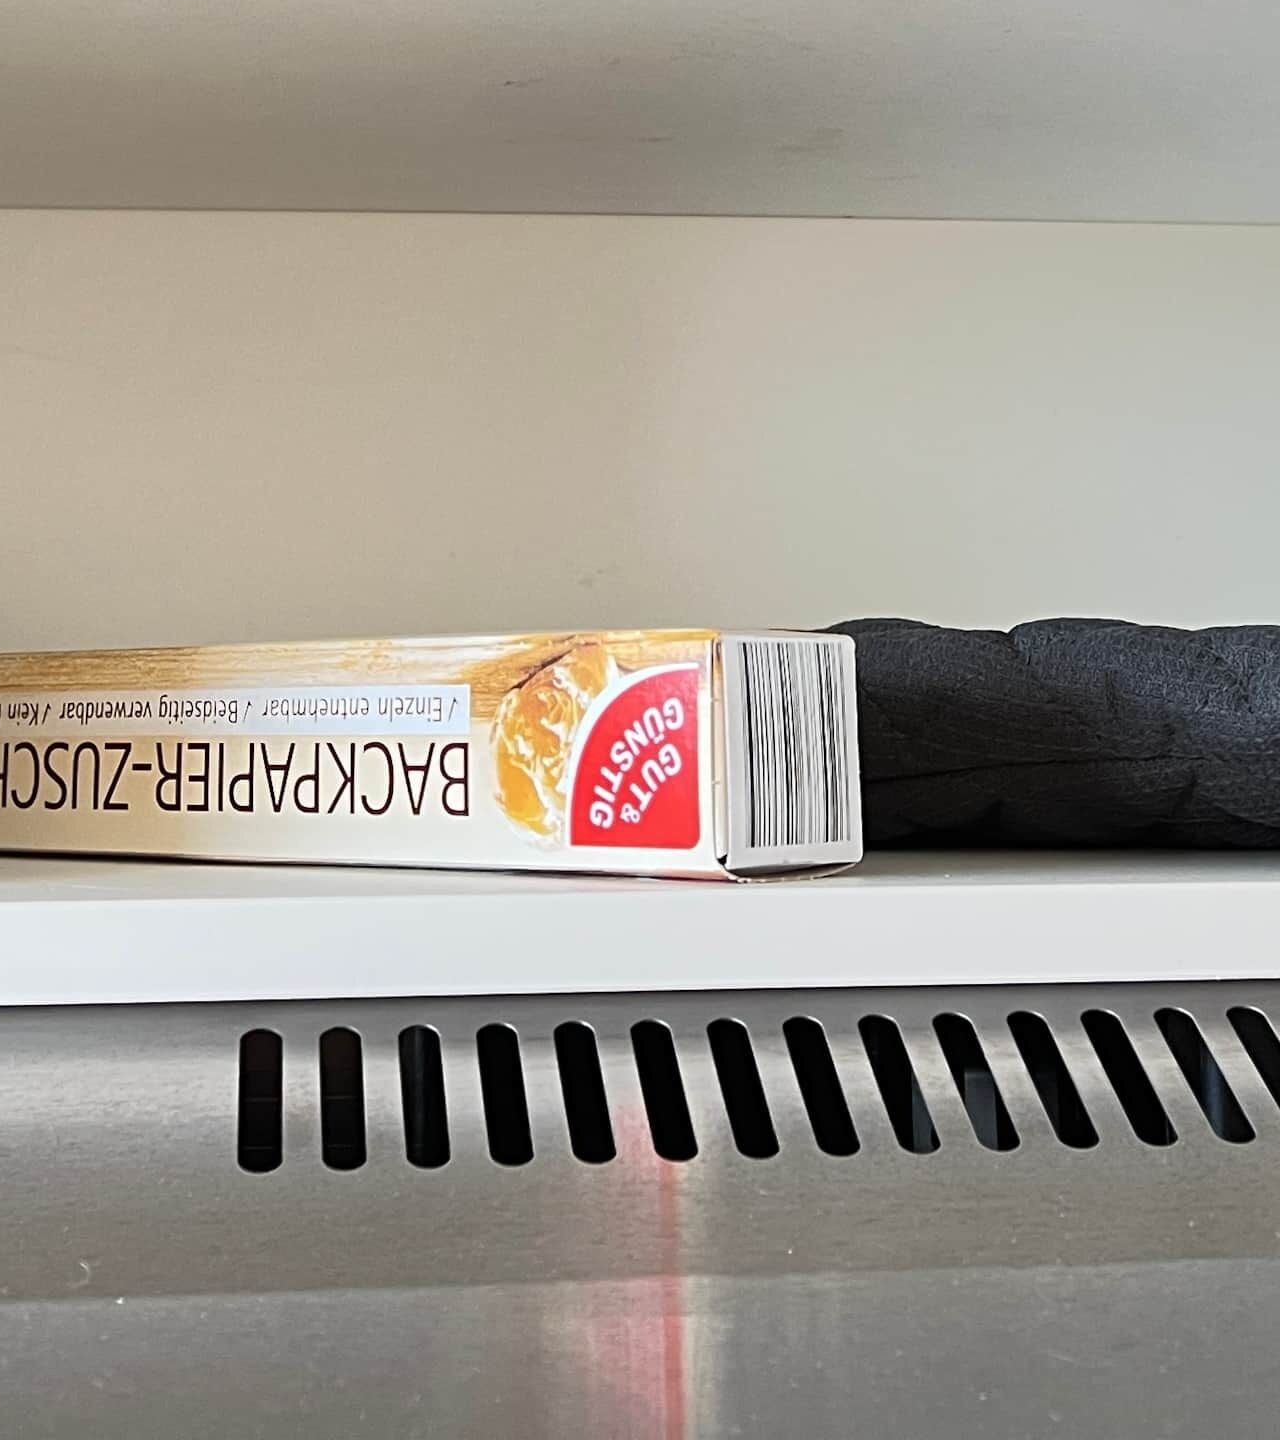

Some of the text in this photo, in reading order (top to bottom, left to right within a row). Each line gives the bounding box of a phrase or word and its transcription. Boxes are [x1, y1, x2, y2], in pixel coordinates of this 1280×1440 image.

[7, 702, 39, 727] Kein
[58, 700, 152, 726] verwendbar
[158, 694, 238, 725] Beidseitig
[262, 696, 369, 724] entnehmbar
[378, 696, 442, 723] Einzeln
[589, 697, 685, 829] GÜNSTIG
